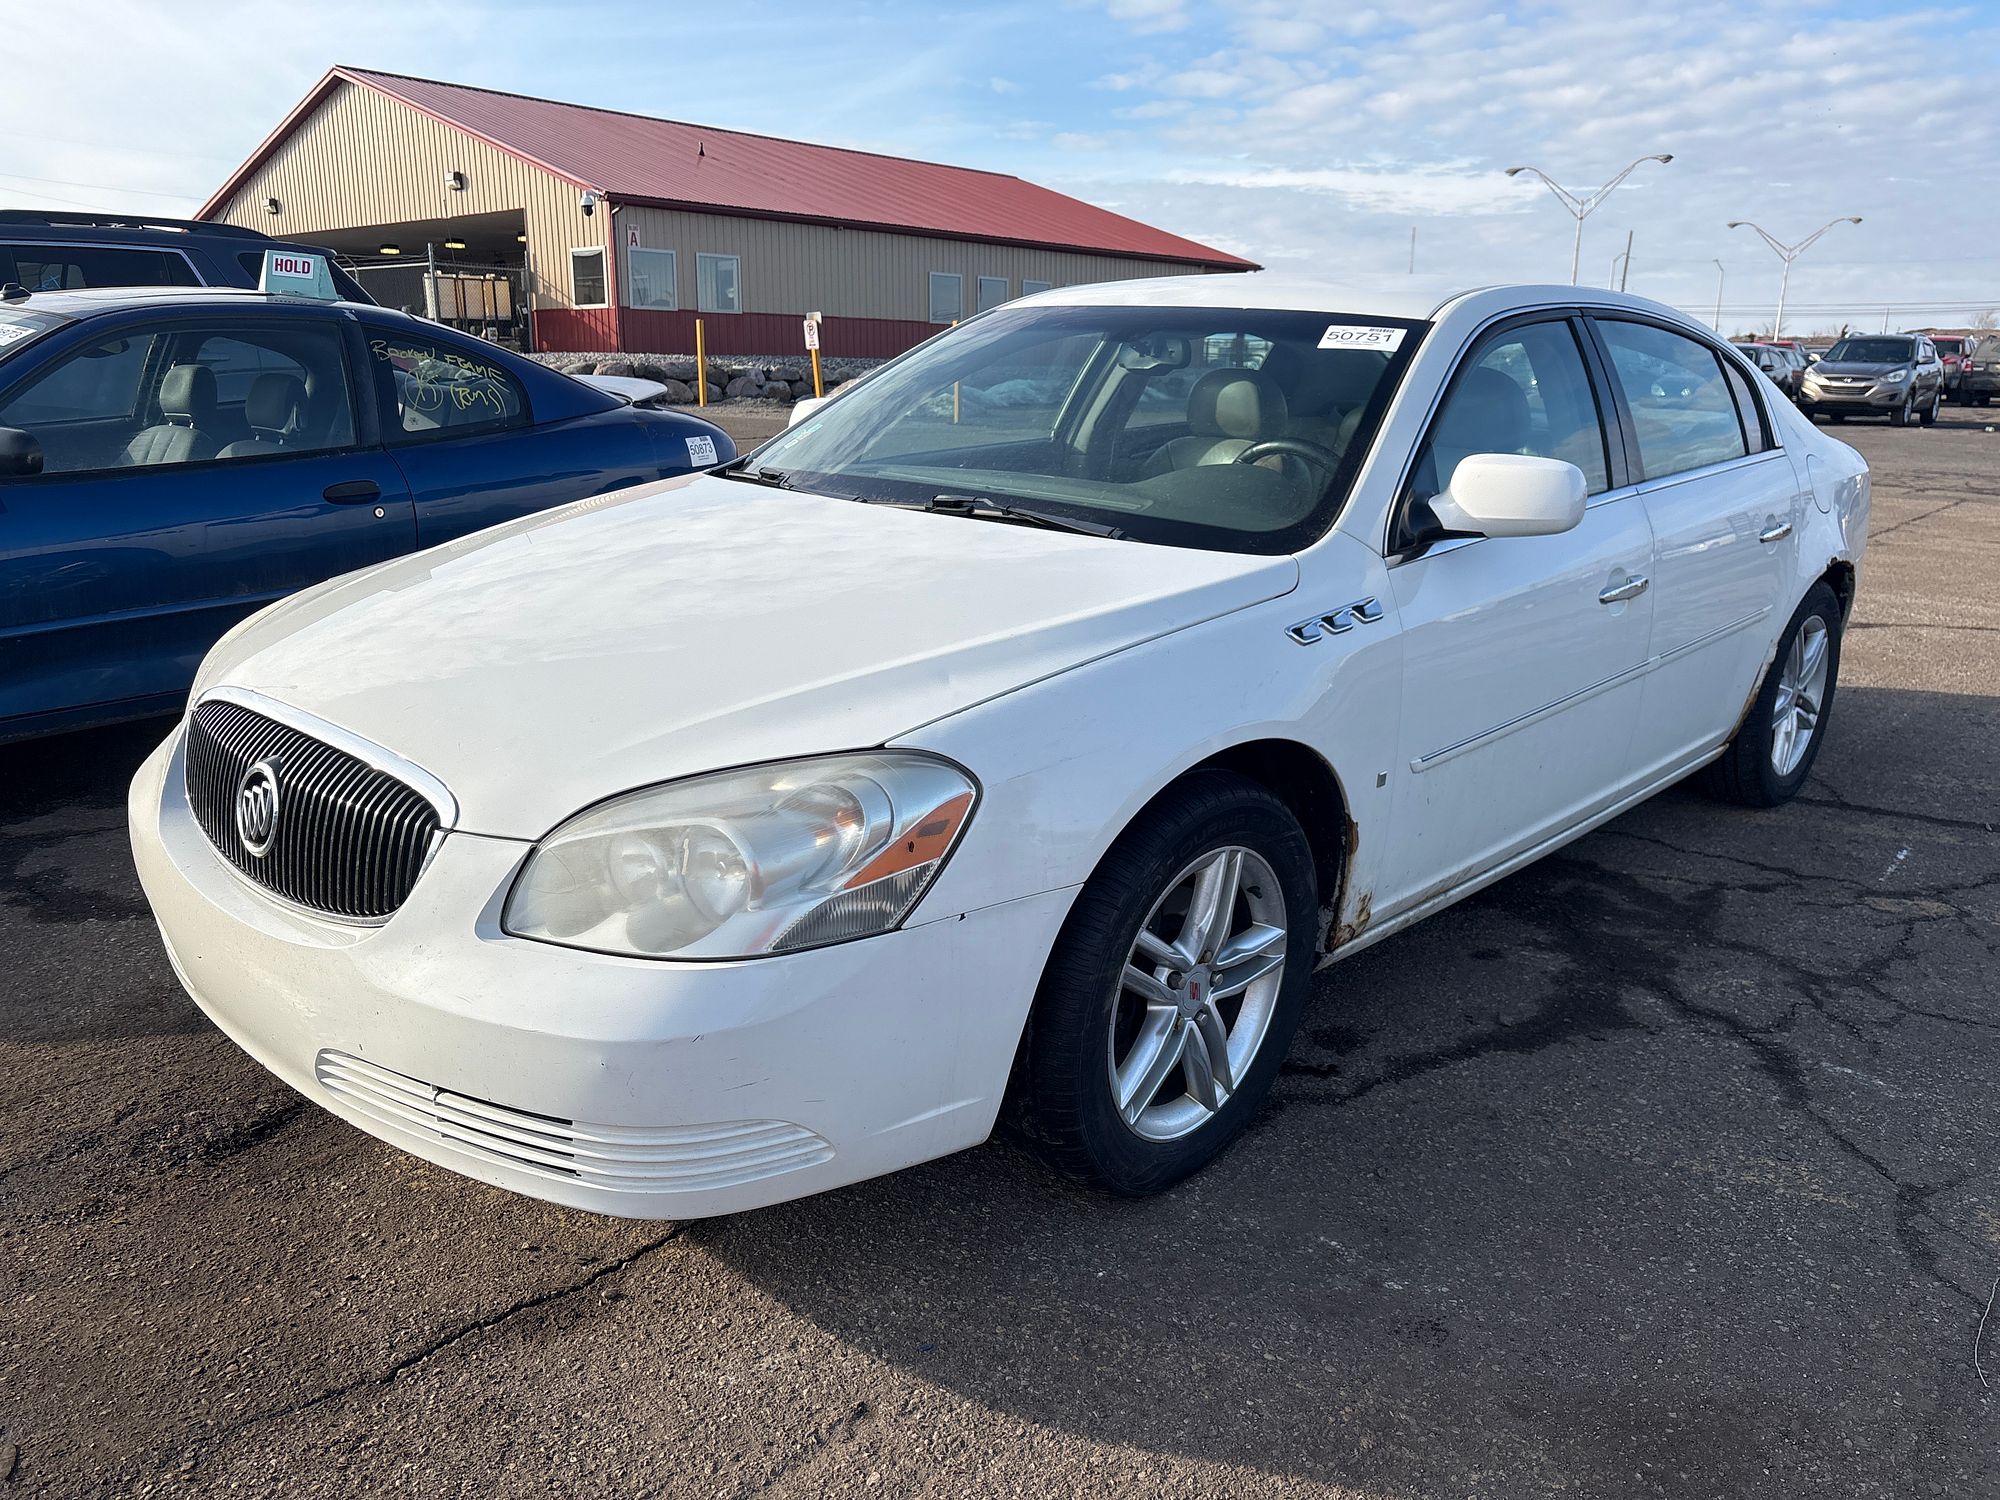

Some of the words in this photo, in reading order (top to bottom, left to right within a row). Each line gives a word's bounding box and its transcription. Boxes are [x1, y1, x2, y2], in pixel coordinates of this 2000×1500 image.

[630, 232, 638, 247] A
[274, 257, 311, 274] HOLD
[1326, 332, 1393, 343] 50751
[689, 442, 714, 456] 50873
